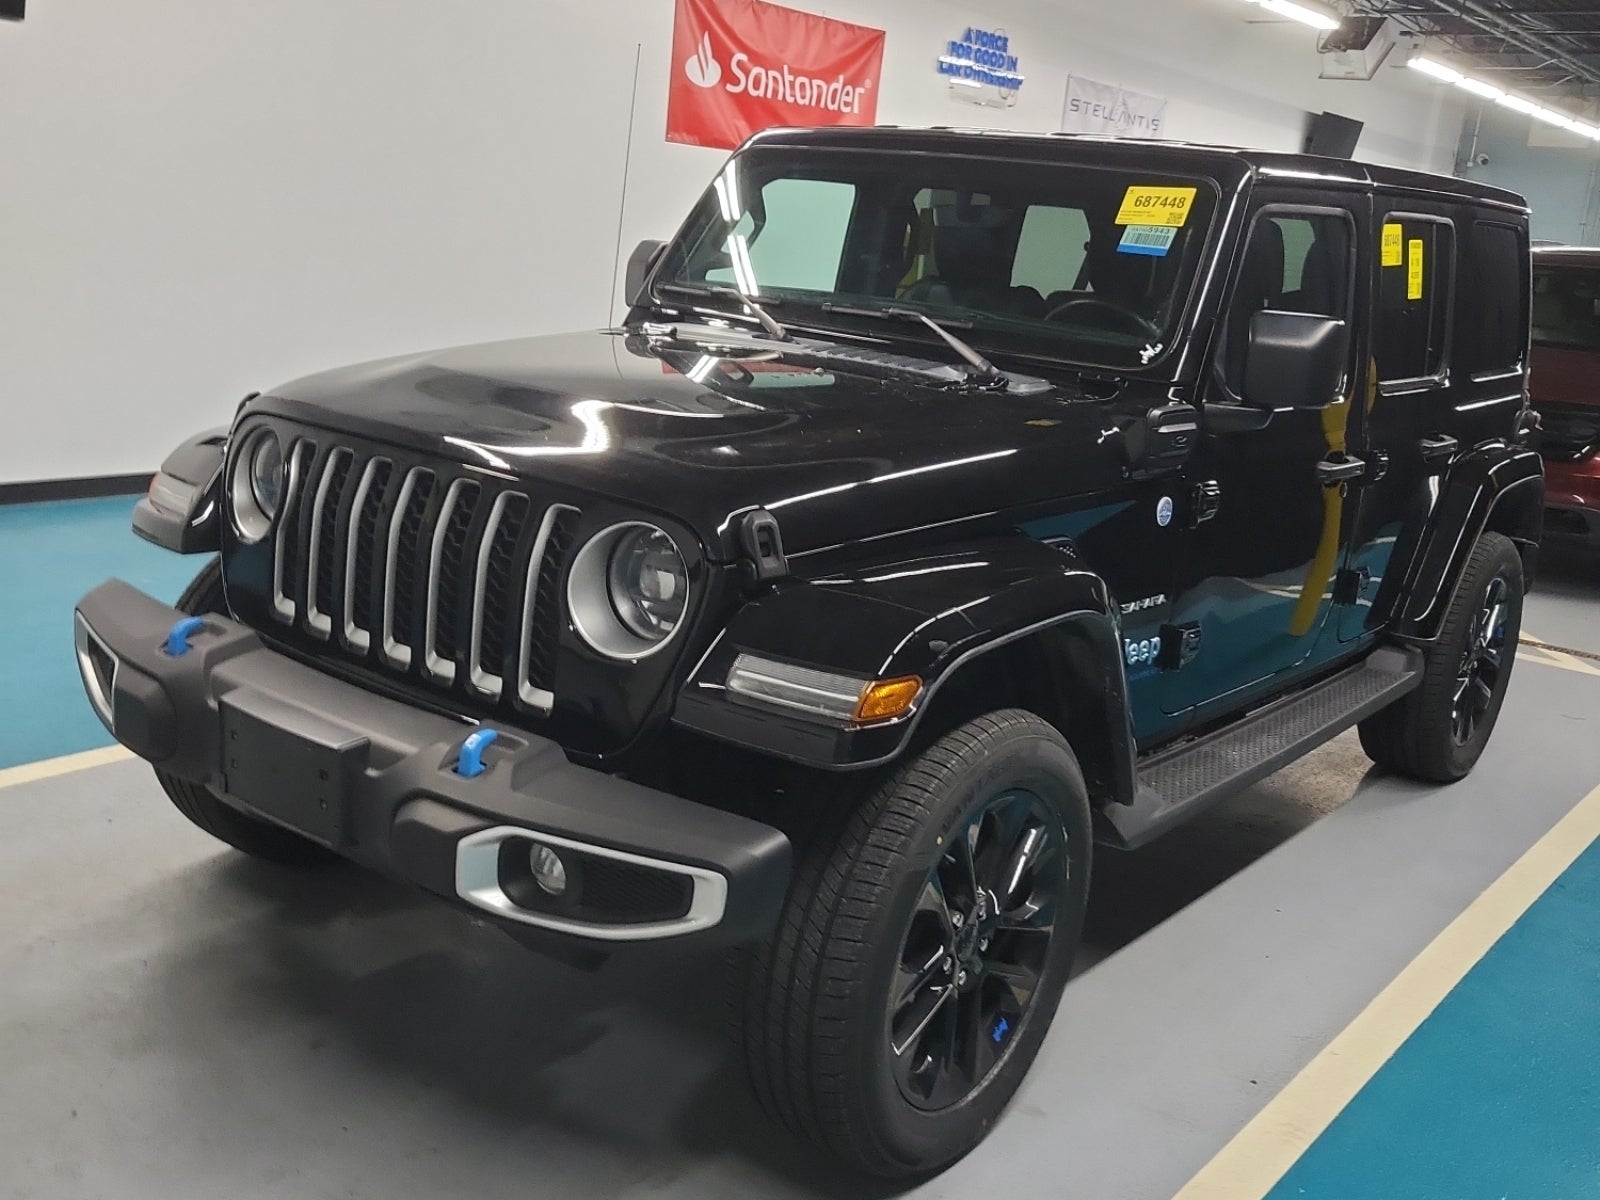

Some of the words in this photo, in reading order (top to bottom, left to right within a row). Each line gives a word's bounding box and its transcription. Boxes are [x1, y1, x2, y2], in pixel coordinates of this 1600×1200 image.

[963, 27, 973, 44] A
[975, 29, 1009, 53] FORCE
[949, 40, 973, 61] FOR
[974, 47, 1006, 69] GOOD
[1006, 55, 1019, 72] IN
[725, 52, 866, 114] Santander
[1069, 98, 1161, 131] STELLANTIS
[1134, 195, 1187, 209] 687448
[1120, 593, 1167, 614] SAHARA
[1123, 636, 1161, 666] Jeep
